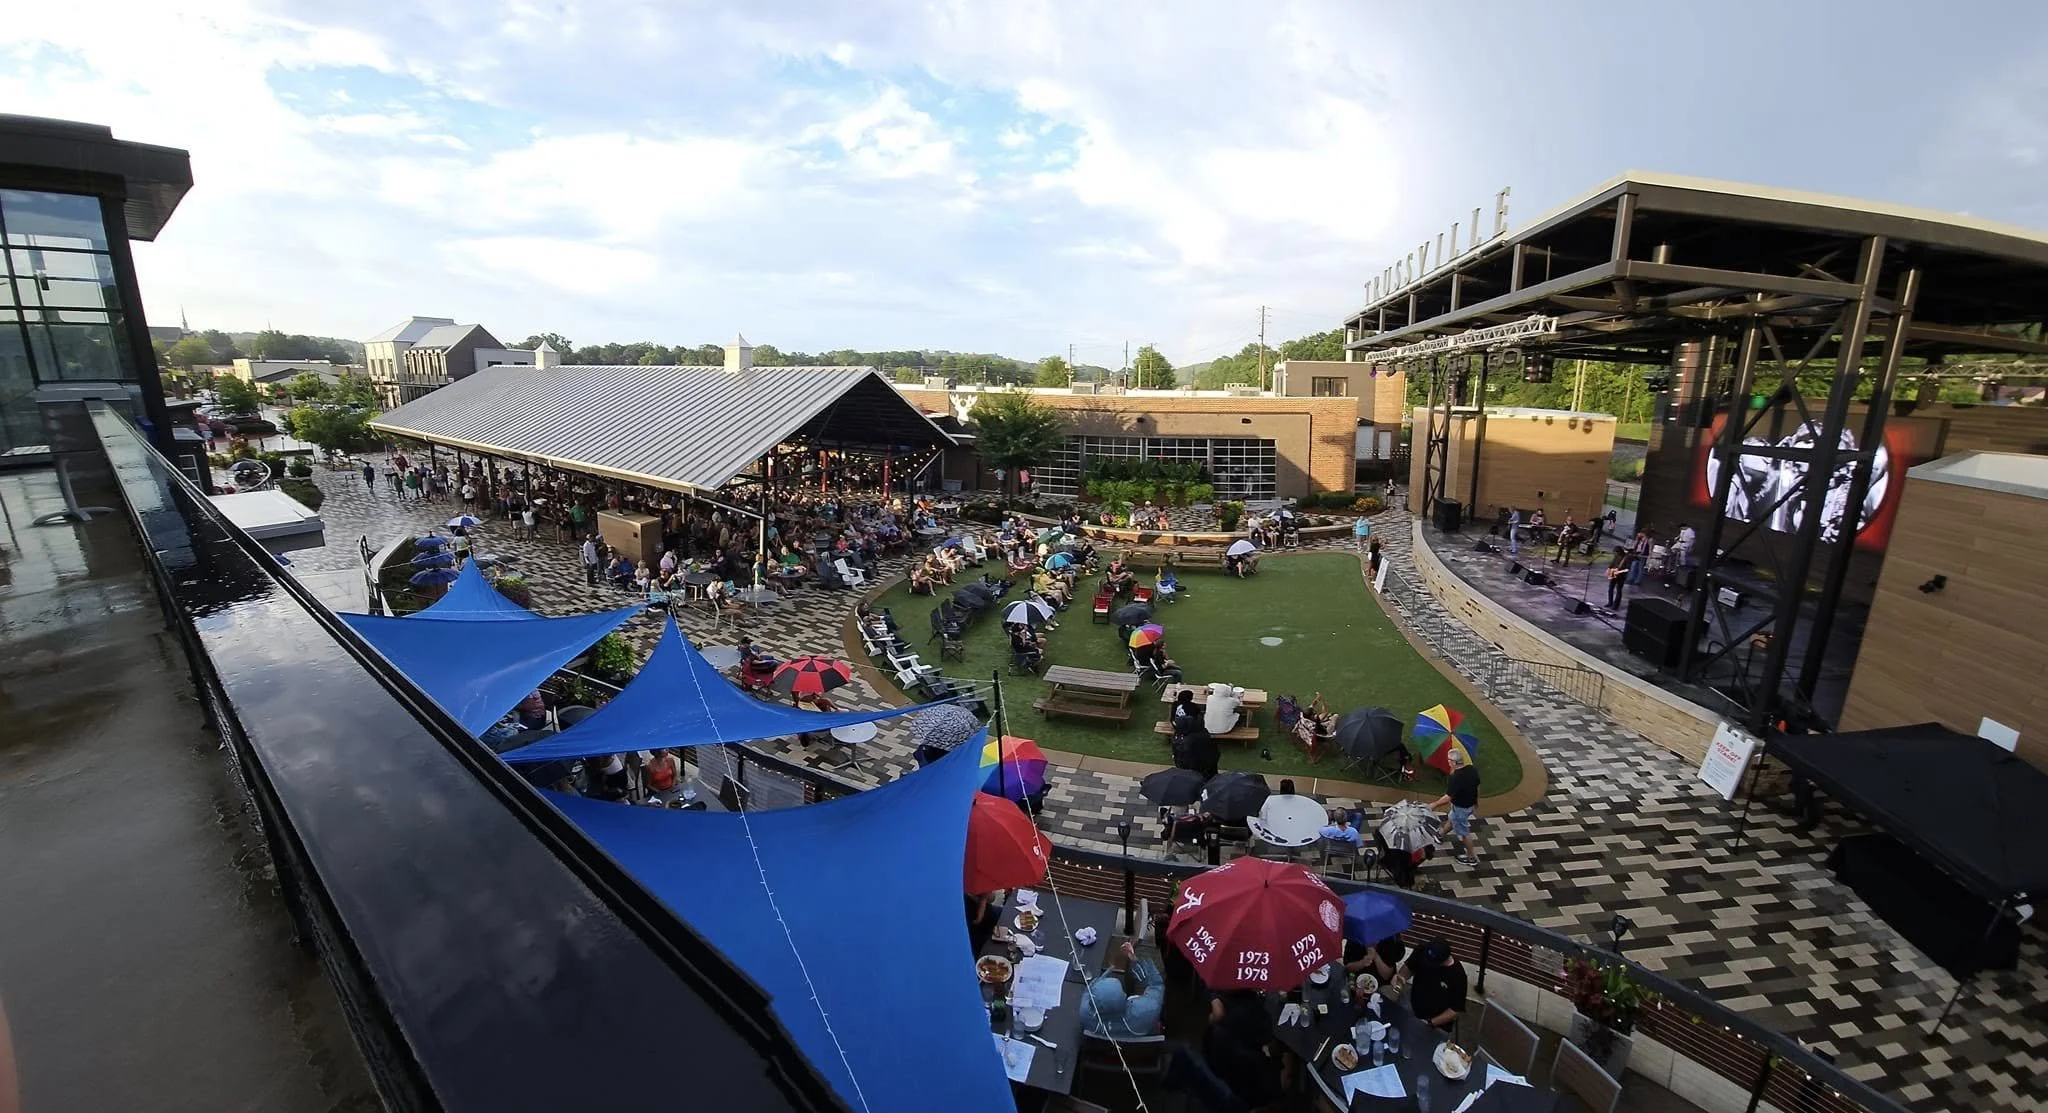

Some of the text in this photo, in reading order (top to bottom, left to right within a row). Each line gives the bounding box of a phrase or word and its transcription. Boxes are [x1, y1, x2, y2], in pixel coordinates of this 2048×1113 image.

[1364, 186, 1511, 306] TRUSSVILLE
[1716, 742, 1730, 752] KEEP
[1185, 937, 1207, 964] 1965
[1195, 925, 1218, 952] 1964
[1290, 933, 1316, 957] 1979
[1238, 951, 1270, 965] 1973
[1297, 947, 1324, 972] 1992
[1236, 967, 1269, 981] 1978
